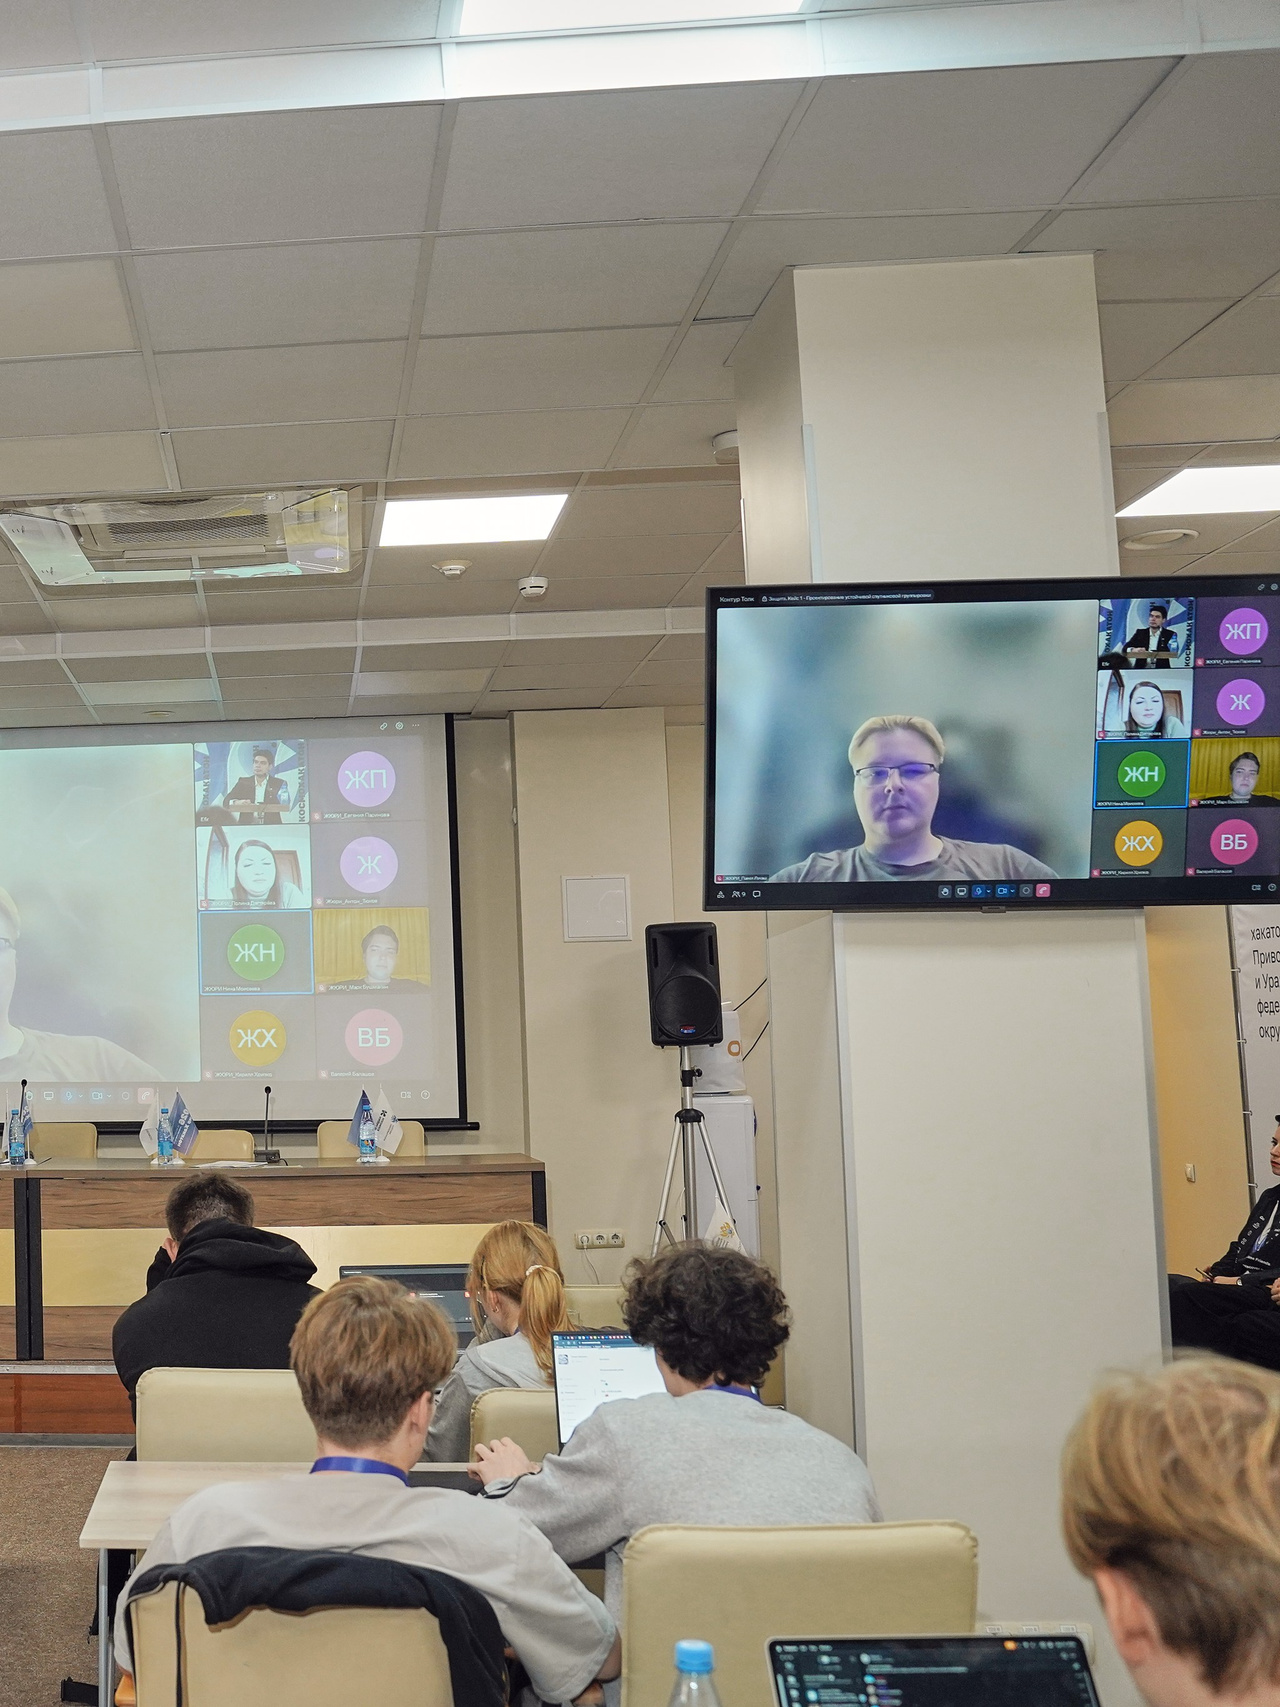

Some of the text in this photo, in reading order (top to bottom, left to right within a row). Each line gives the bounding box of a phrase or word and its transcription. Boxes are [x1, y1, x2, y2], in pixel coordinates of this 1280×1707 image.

[1105, 609, 1113, 652] ОХАКАТОН
[1225, 623, 1261, 640] ЖП
[1230, 694, 1252, 710] Ж
[344, 769, 387, 790] ЖП
[1124, 766, 1159, 782] ЖН
[1122, 835, 1155, 851] ЖХ
[1220, 834, 1248, 850] ВБ
[357, 855, 382, 874] Ж
[234, 943, 275, 962] ЖН
[237, 1028, 277, 1048] ЖХ
[358, 1027, 391, 1047] ВБ
